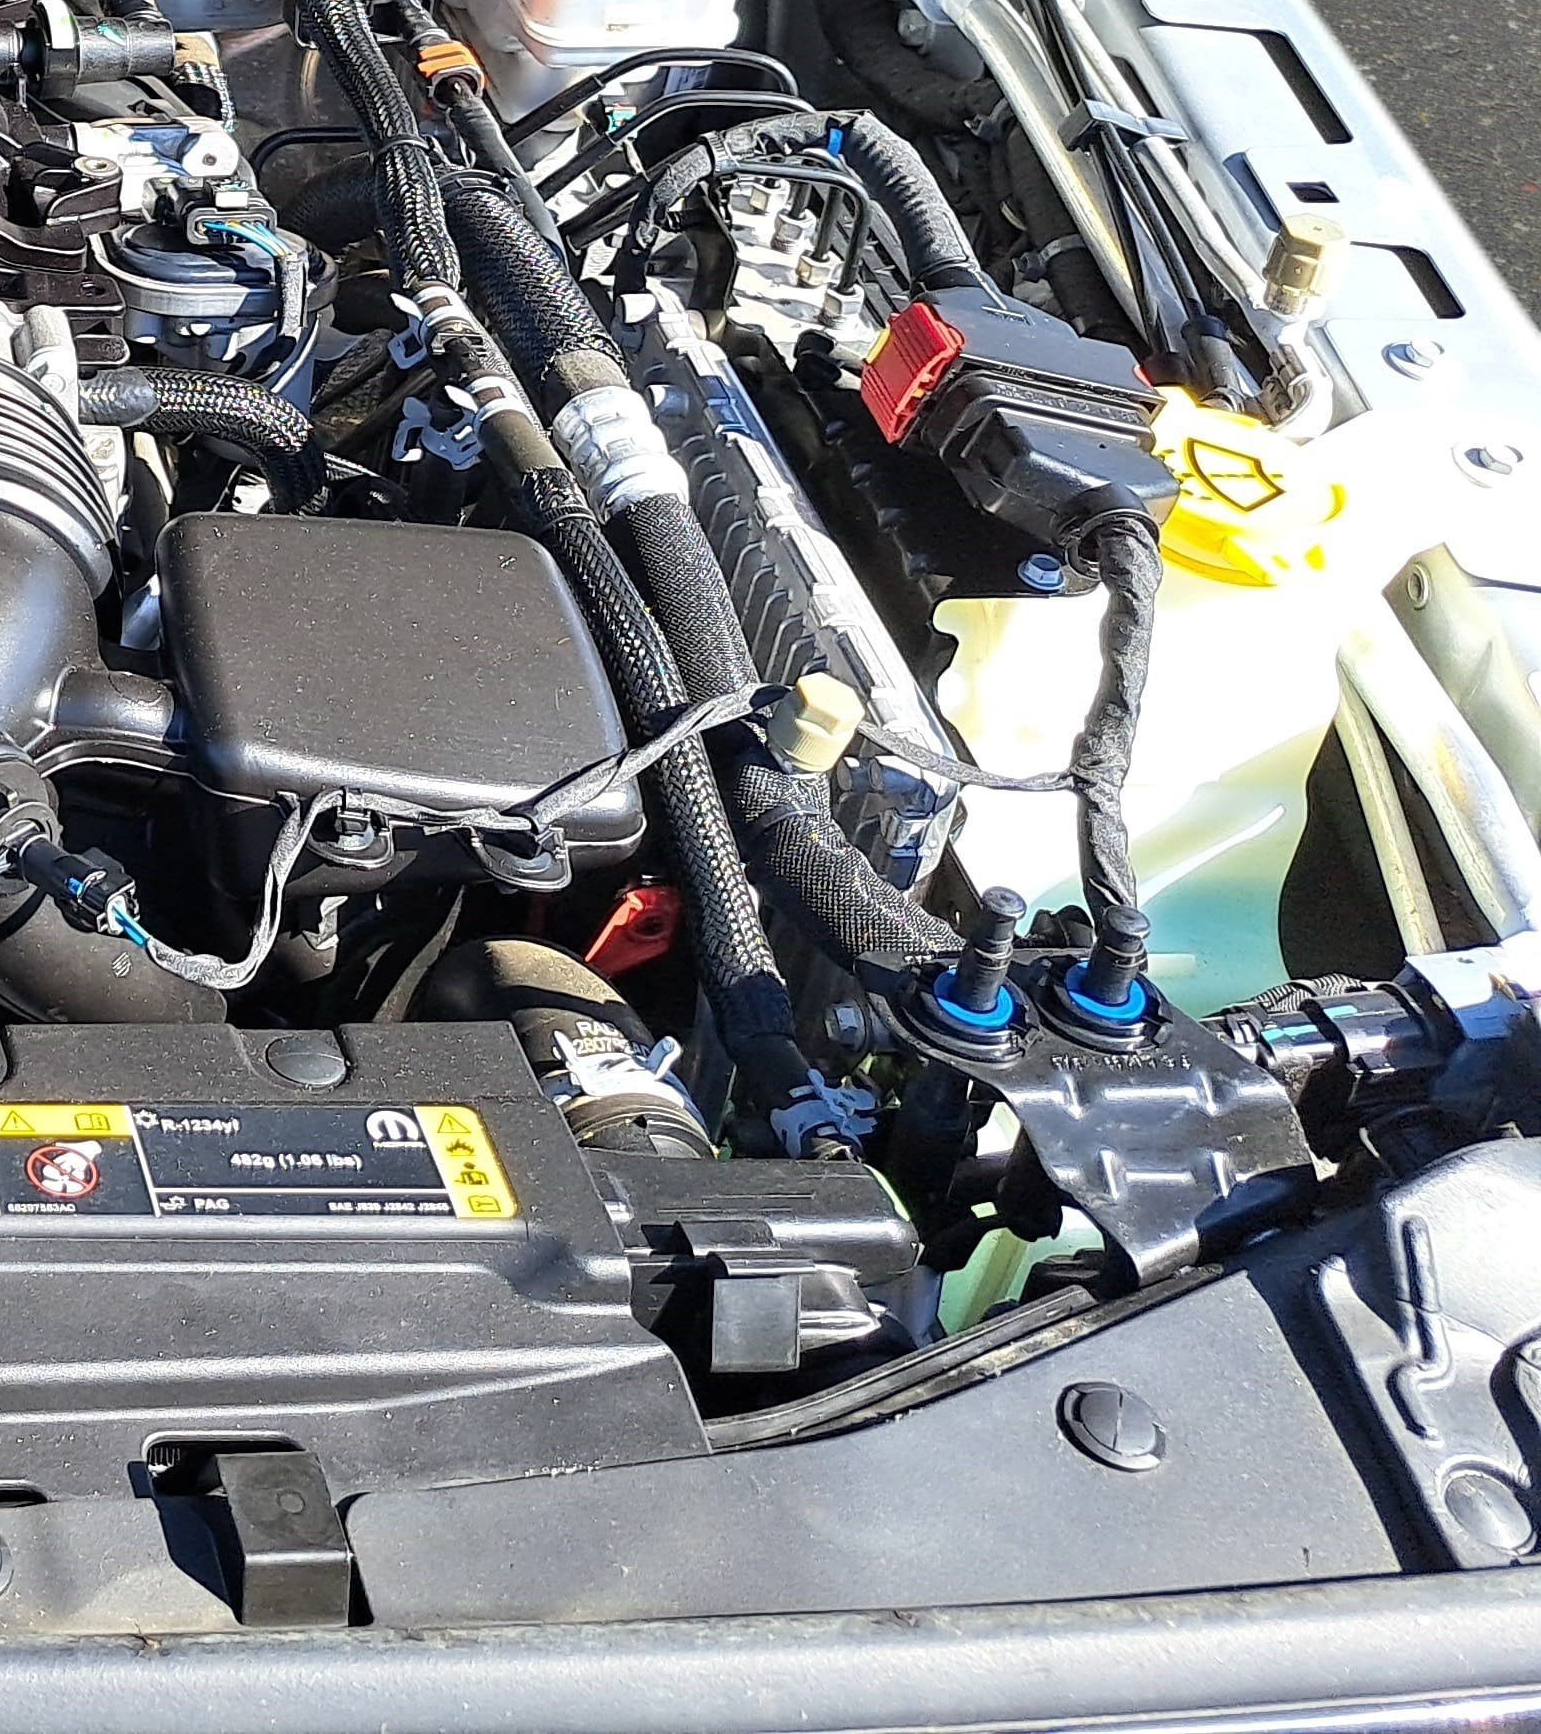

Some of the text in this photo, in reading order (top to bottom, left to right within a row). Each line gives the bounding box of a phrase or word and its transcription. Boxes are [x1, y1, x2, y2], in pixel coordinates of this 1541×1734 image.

[230, 1153, 275, 1169] 482g
[325, 1153, 364, 1171] lbs)
[194, 1198, 230, 1212] PAG
